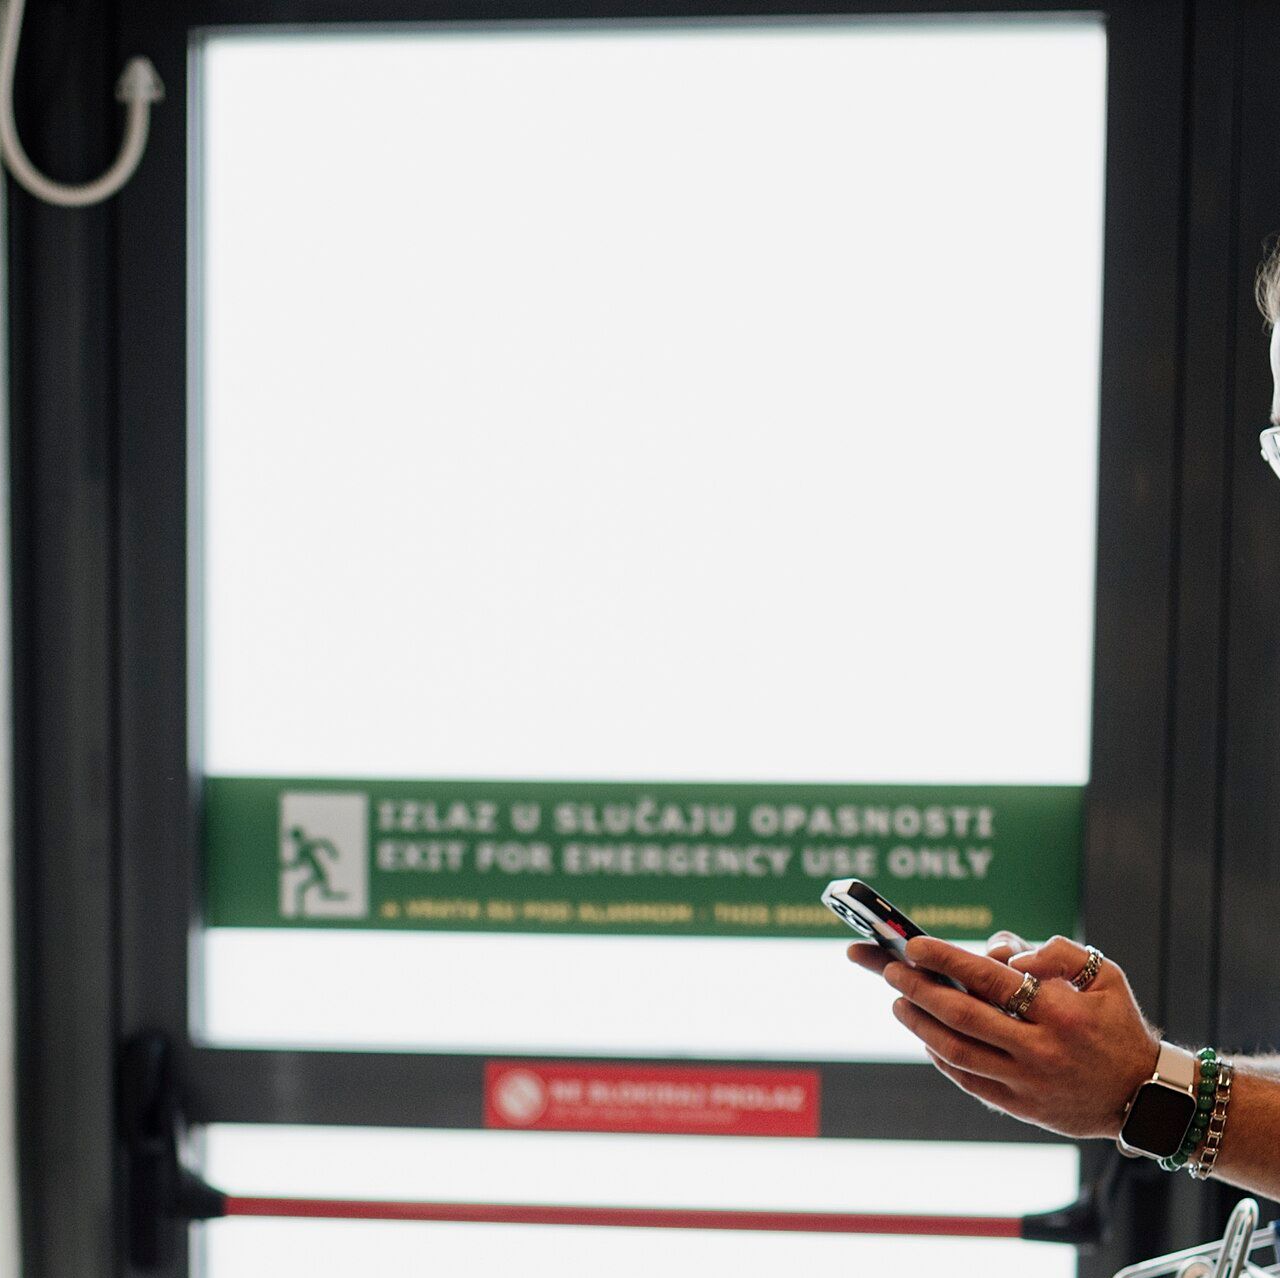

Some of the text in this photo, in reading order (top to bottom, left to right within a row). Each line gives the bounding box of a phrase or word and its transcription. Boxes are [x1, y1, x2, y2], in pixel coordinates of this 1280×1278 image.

[377, 795, 994, 838] IZLAZ U SLUČAJU OPASNOSTI
[377, 840, 994, 879] EXIT FOR EMERGENCY USE ONLY
